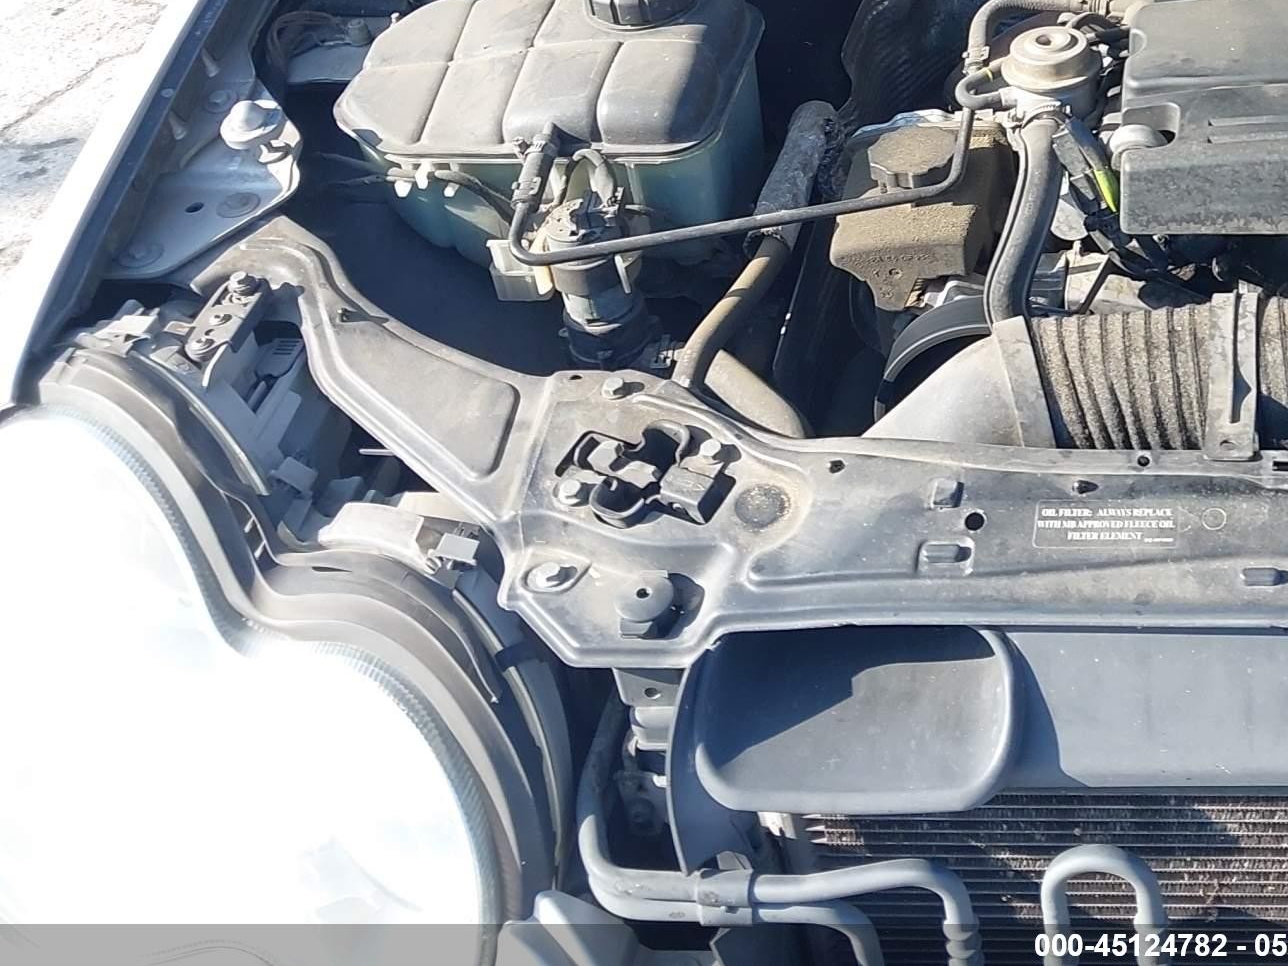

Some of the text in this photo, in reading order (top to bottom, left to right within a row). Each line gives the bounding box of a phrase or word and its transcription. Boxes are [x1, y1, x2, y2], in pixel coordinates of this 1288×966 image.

[1041, 508, 1058, 517] OIL
[1096, 508, 1132, 517] ALWAYS
[1133, 508, 1173, 517] REPLACE
[1037, 520, 1062, 529] WITH
[1078, 520, 1124, 529] APPROVED
[1159, 520, 1176, 528] OIL
[1067, 531, 1143, 540] FILTER ELEMENT
